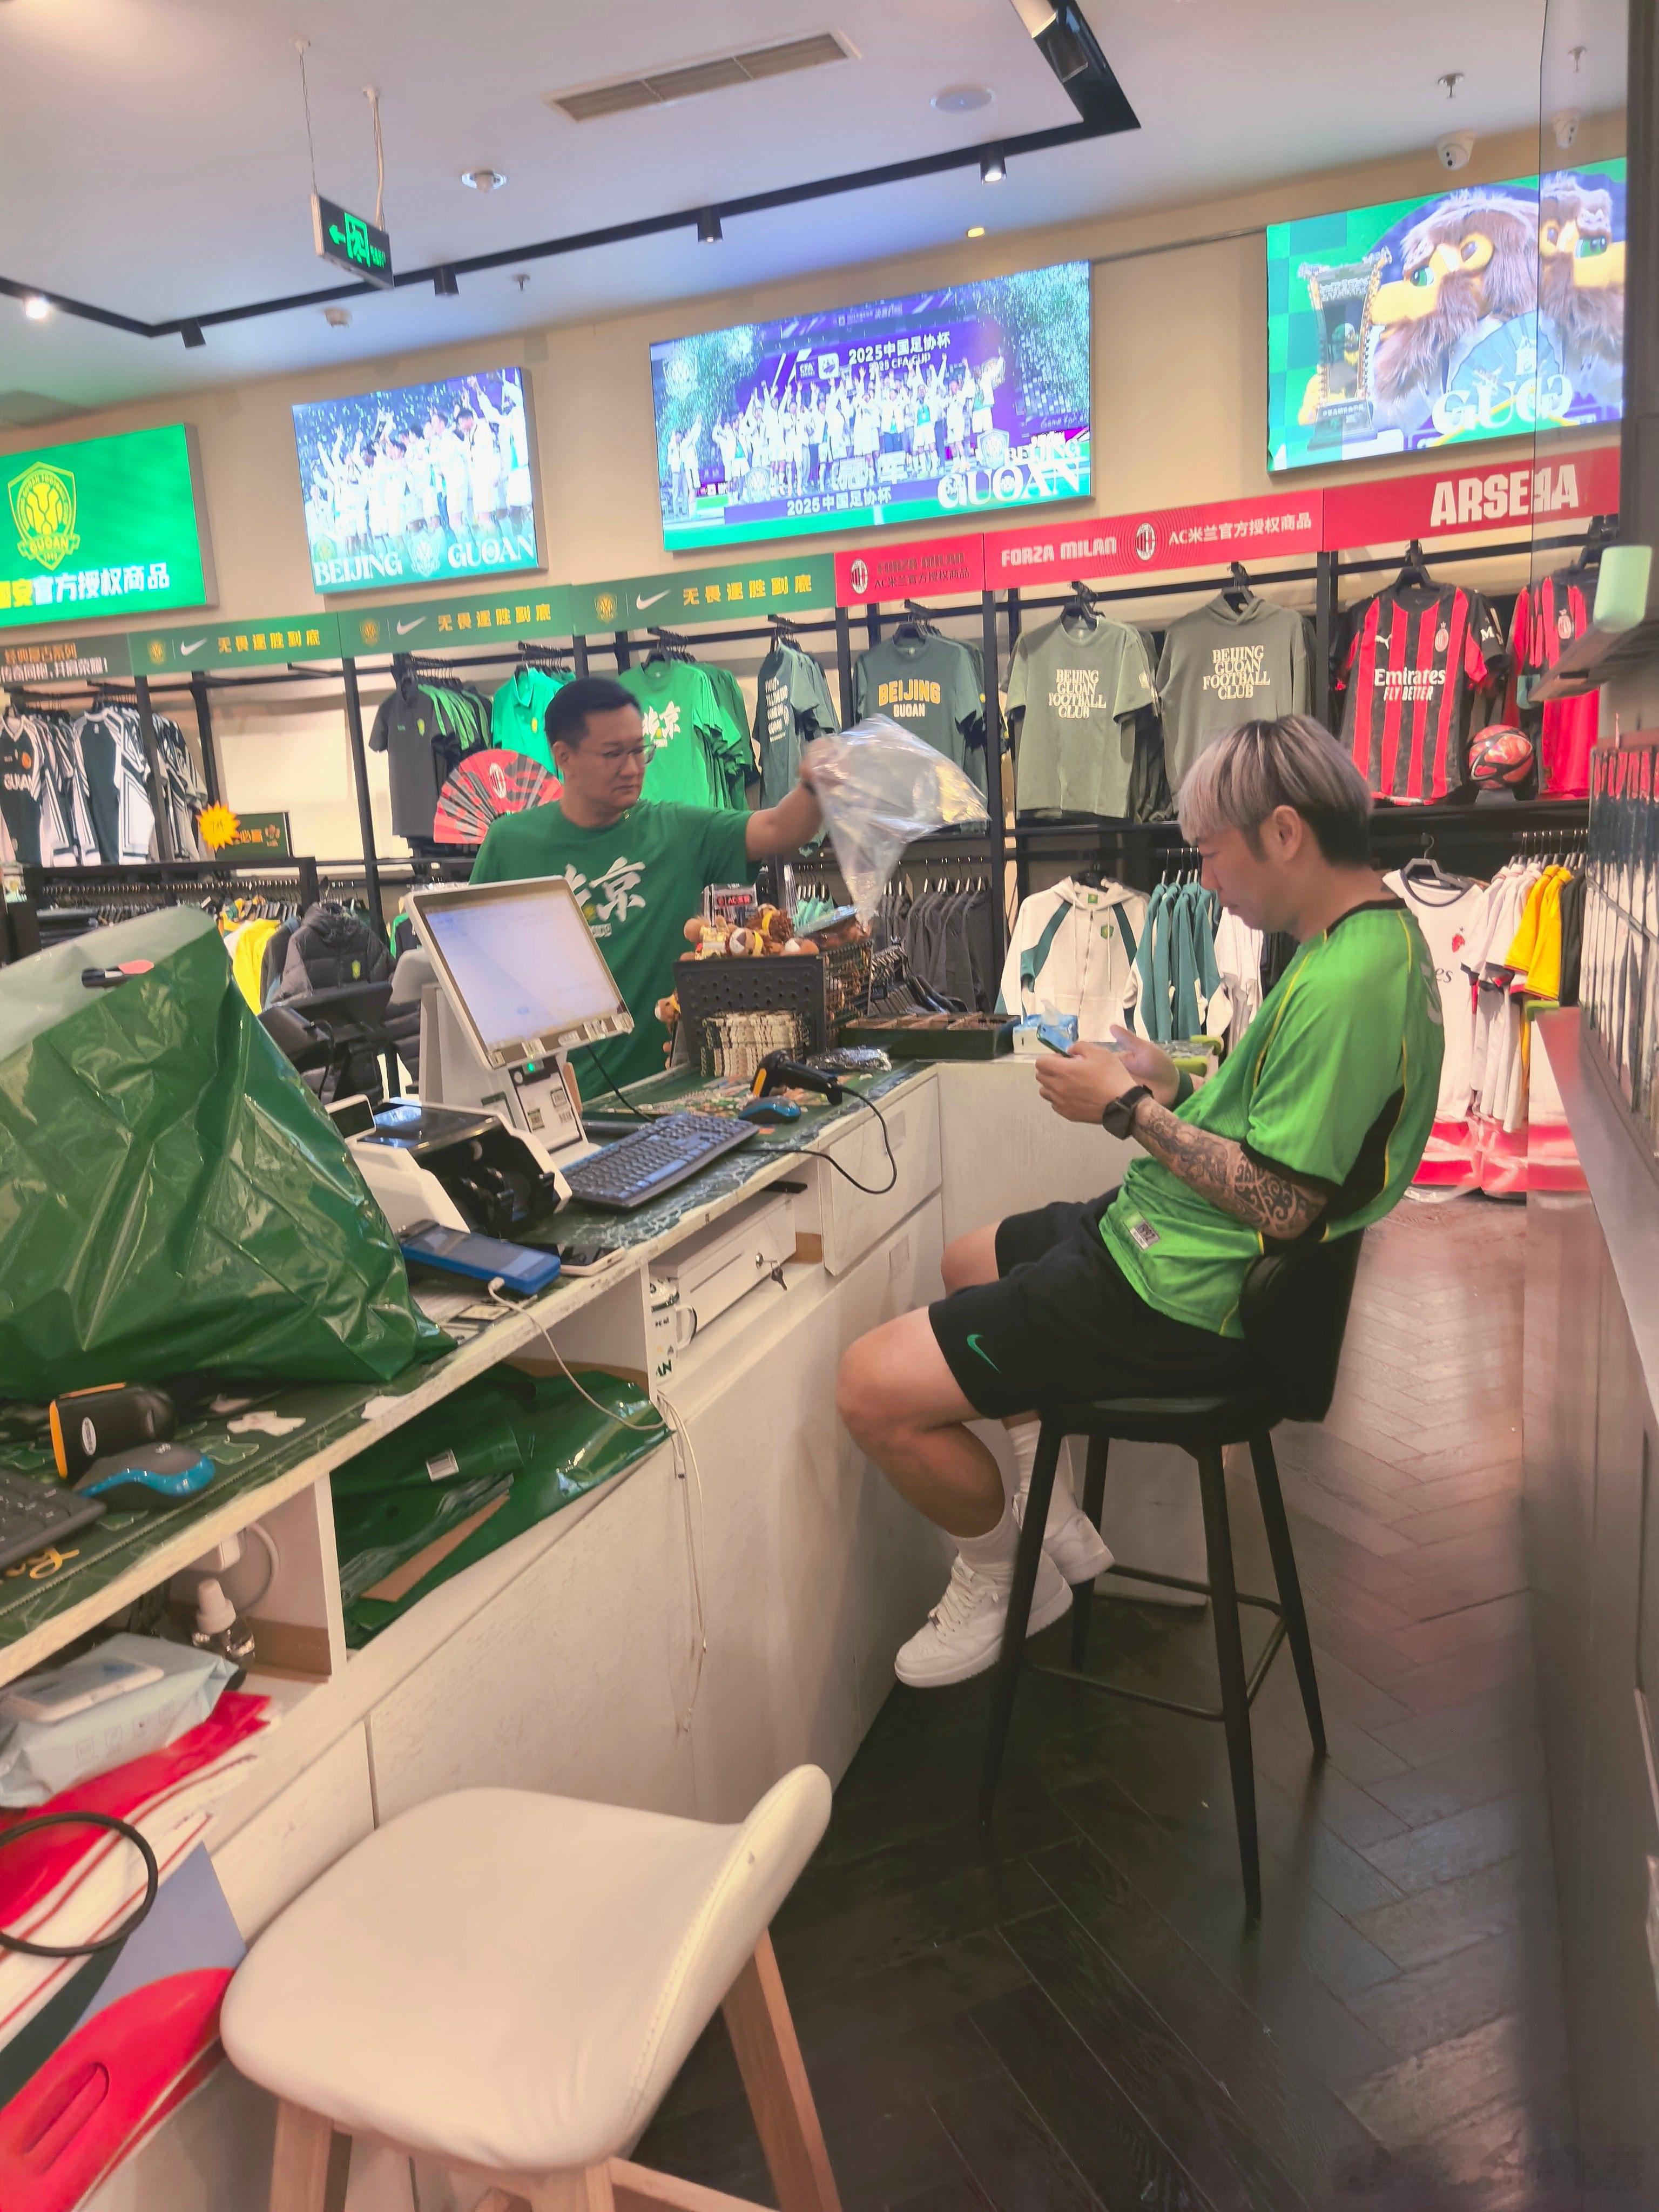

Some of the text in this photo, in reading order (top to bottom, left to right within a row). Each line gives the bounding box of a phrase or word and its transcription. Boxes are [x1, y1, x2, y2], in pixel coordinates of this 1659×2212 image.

[848, 331, 950, 365] 2025中国足协杯
[937, 458, 1081, 509] GUOAN
[787, 485, 892, 516] 2025中国足协杯
[1169, 512, 1312, 545] AC米兰官方授权商品
[314, 535, 536, 586] BEIJING GUOAN
[1001, 536, 1117, 568] FORZA MILAN
[1212, 645, 1264, 664] BEIJING
[1055, 669, 1100, 684] BEIJING
[1215, 658, 1262, 676] GUOAN
[1374, 666, 1446, 686] Emirates
[1056, 682, 1097, 696] GUOAN
[1202, 671, 1271, 690] FOOTBALL
[878, 678, 941, 706] BEIJING
[1048, 692, 1107, 709] FOOTBALL
[1218, 684, 1253, 700] CLUB
[1383, 685, 1434, 701] FLY BETTER
[893, 703, 925, 718] GUOAN
[1058, 704, 1090, 719] CLUB
